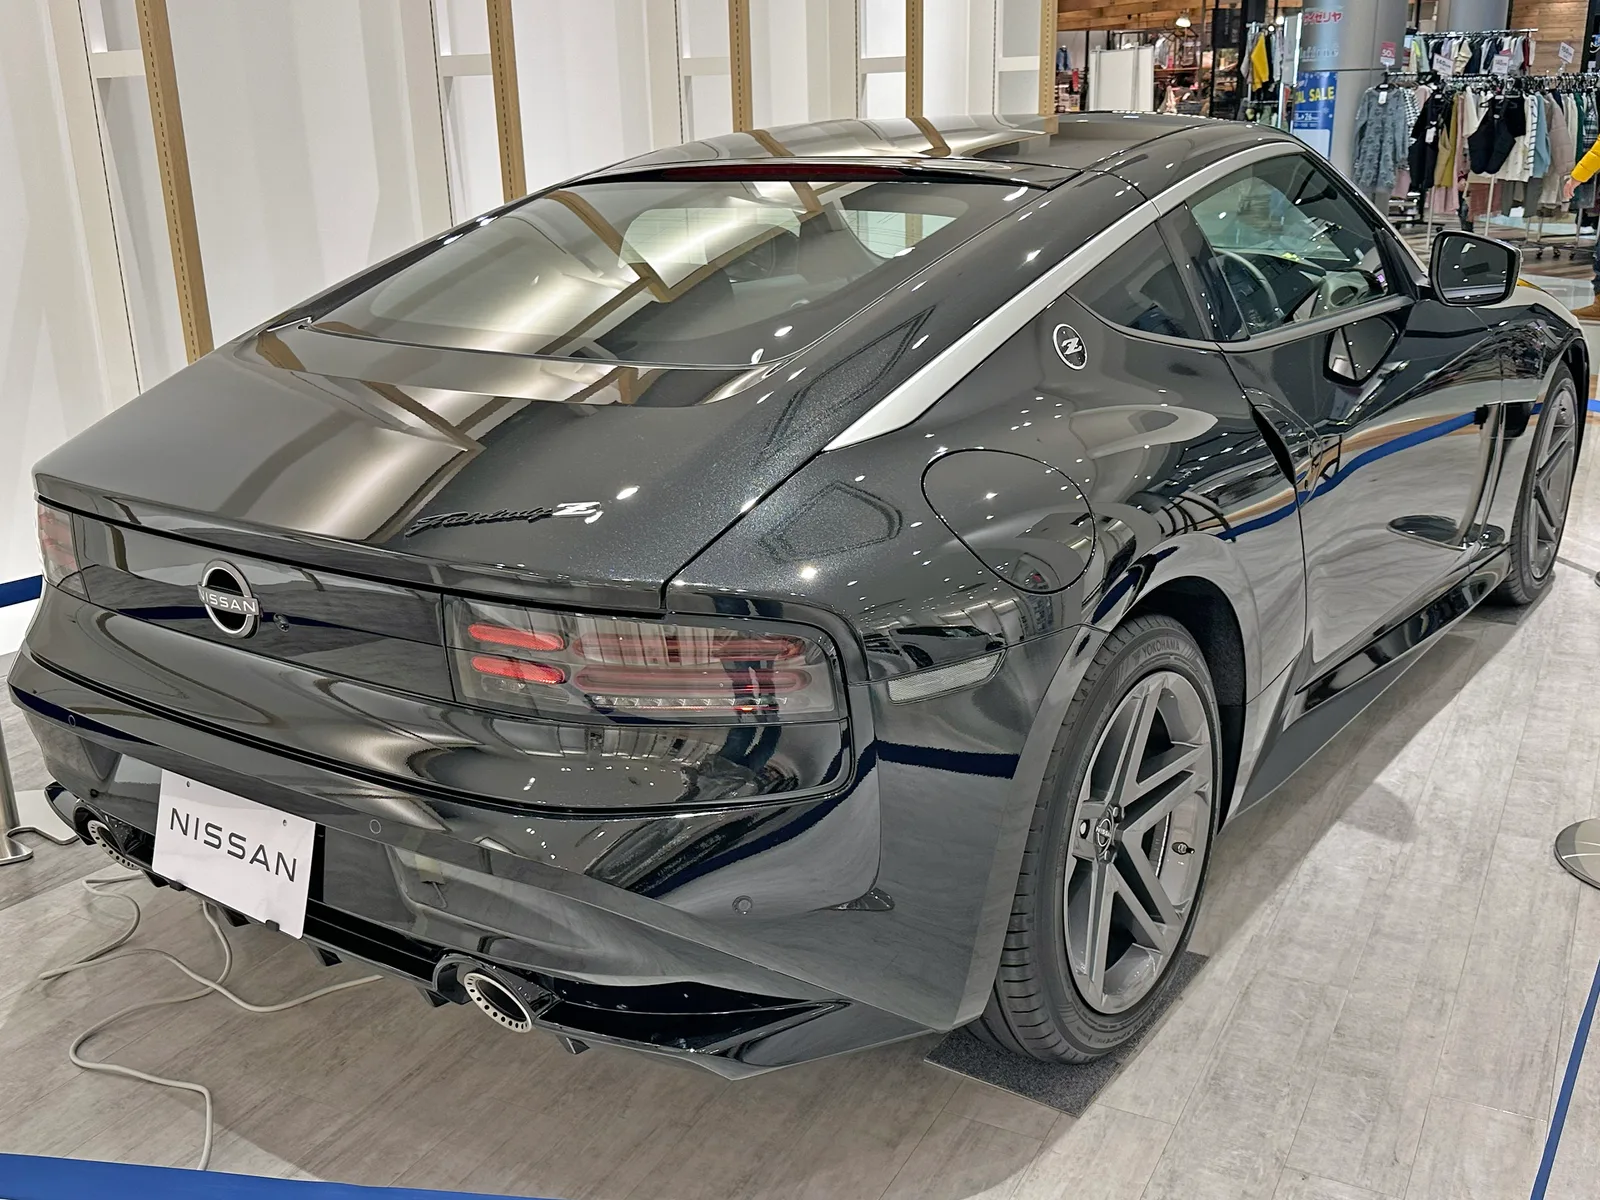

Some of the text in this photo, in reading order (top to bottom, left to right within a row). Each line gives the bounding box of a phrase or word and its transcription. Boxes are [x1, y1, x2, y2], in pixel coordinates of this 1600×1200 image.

[1309, 86, 1335, 102] SALE
[404, 501, 604, 538] Fairlady Z
[198, 589, 257, 613] NISSAN
[1141, 640, 1181, 658] YOKOHAMA
[169, 806, 297, 883] NISSAN
